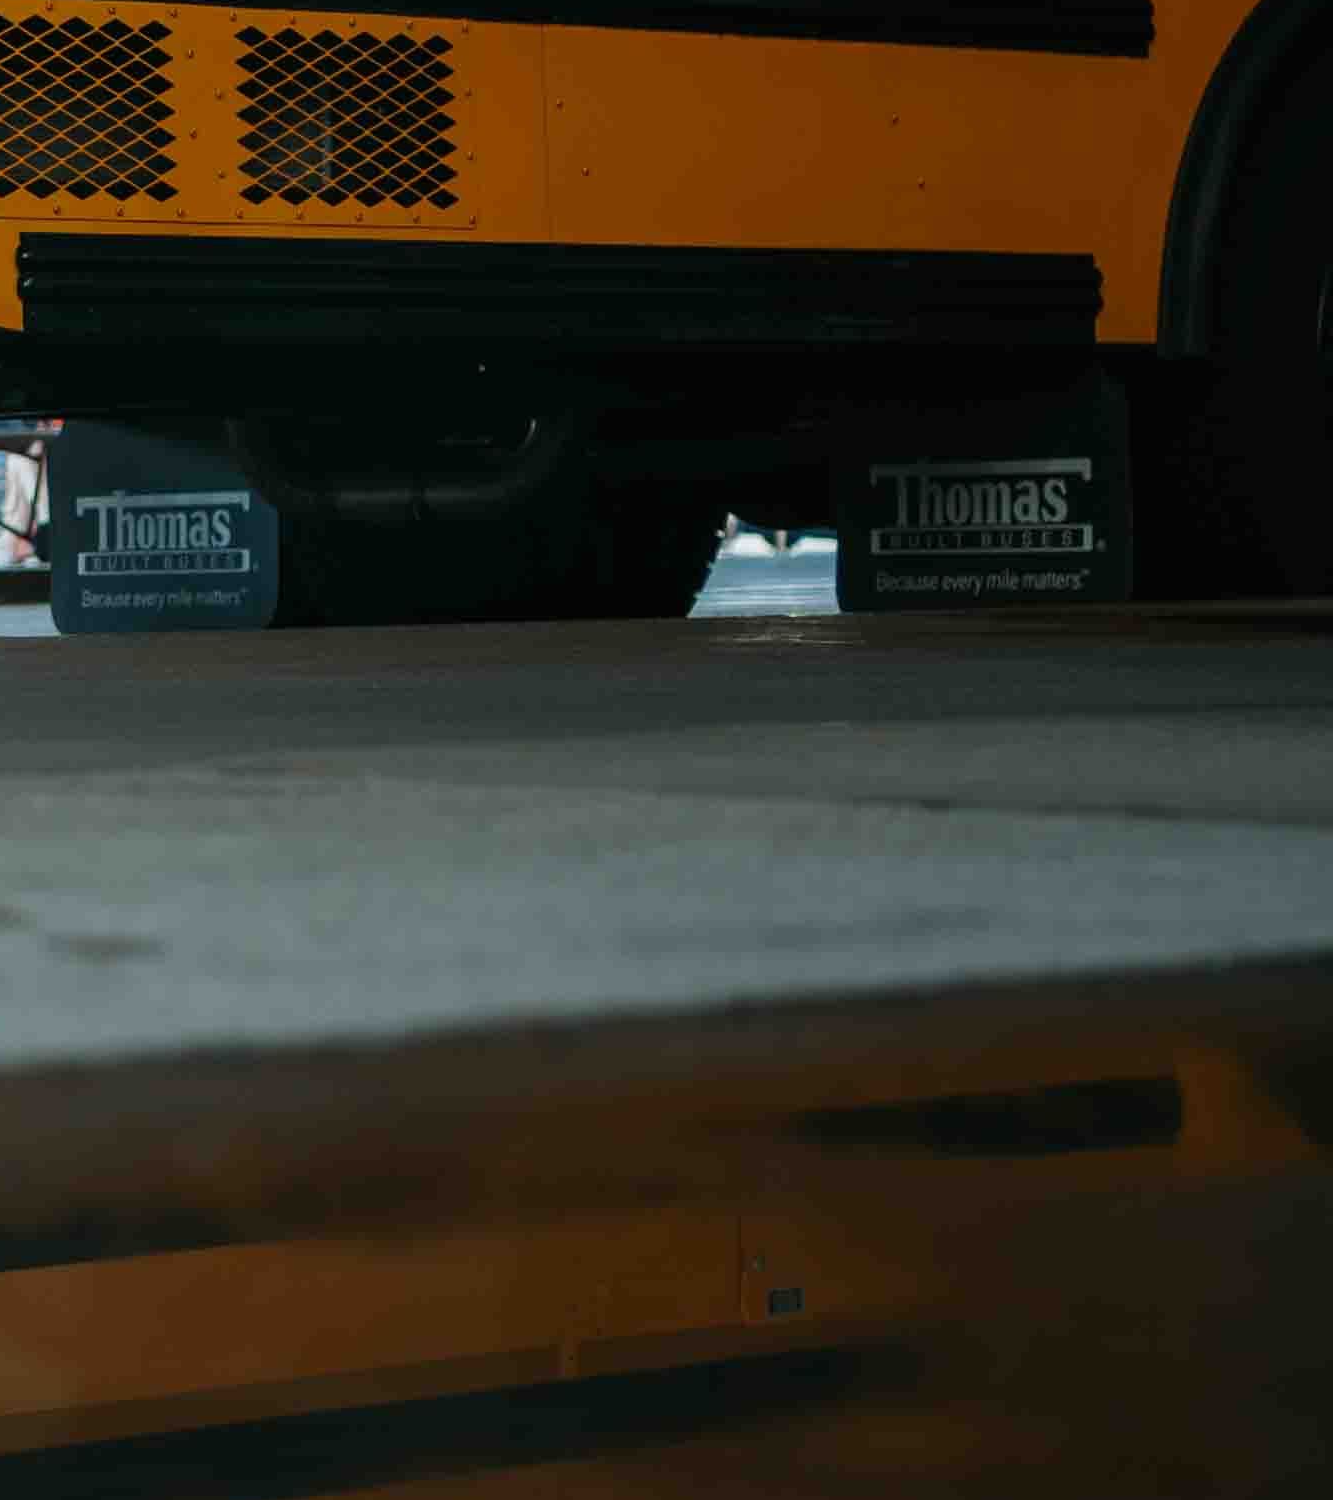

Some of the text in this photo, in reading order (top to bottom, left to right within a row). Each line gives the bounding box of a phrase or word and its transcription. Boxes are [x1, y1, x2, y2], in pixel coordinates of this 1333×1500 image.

[870, 458, 1092, 529] Thomas
[77, 489, 250, 552] Thomas
[888, 530, 1074, 548] BUILT BUSES
[876, 571, 939, 593] Because
[941, 574, 981, 598] every
[985, 567, 1019, 591] mile
[80, 589, 134, 609] Because
[134, 592, 165, 612] every
